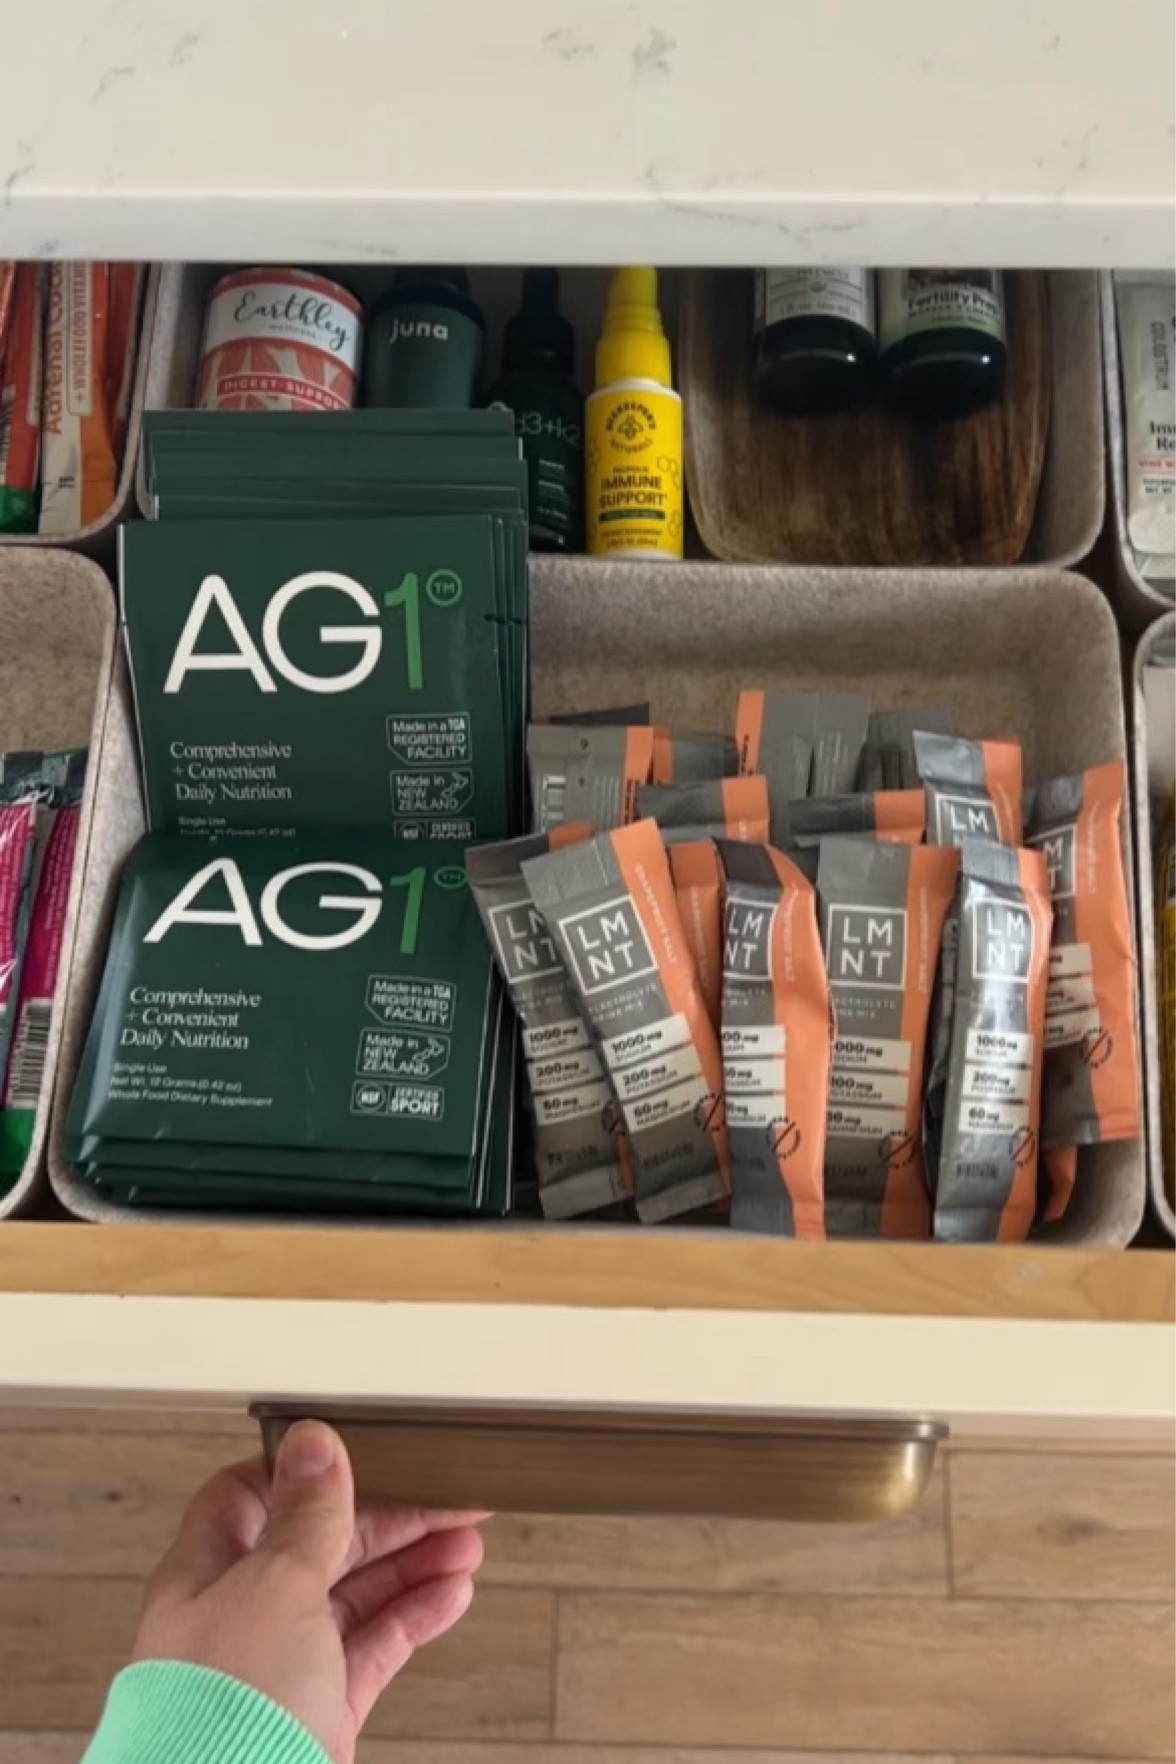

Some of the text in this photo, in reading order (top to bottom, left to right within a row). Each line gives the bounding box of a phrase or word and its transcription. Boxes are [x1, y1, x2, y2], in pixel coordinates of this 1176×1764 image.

[234, 291, 349, 351] Earthley
[389, 318, 449, 344] juna
[223, 378, 276, 392] DIGEST
[601, 476, 661, 490] IMMUNE
[600, 490, 666, 508] SUPPORT
[163, 570, 424, 694] AG1
[393, 720, 427, 733] Made
[427, 721, 438, 732] in
[393, 733, 466, 746] REGISTERED
[170, 740, 292, 763] Comprehensive
[407, 745, 466, 759] FACILITY
[188, 761, 278, 779] Convenient
[396, 774, 445, 787] Made in
[176, 782, 293, 805] Daily Nutrition
[397, 787, 427, 799] NEW
[399, 798, 459, 811] ZEALAND
[949, 803, 990, 833] LM
[142, 857, 426, 953] AG1
[576, 909, 630, 951] LM
[727, 907, 765, 939] LM
[842, 915, 893, 947] LM
[986, 908, 1026, 940] LM
[586, 941, 634, 981] NT
[839, 950, 892, 978] NT
[985, 940, 1025, 970] NT
[373, 980, 408, 994] Made
[410, 984, 423, 994] in
[130, 986, 262, 1009] Comprehensive
[371, 993, 449, 1011] REGISTERED
[142, 1006, 240, 1028] Convenient
[384, 1005, 448, 1027] FACILITY
[120, 1028, 249, 1051] Daily Nutrition
[366, 1033, 419, 1049] Made in
[529, 1027, 562, 1044] 1000
[611, 1034, 645, 1054] 1000
[364, 1046, 397, 1059] NEW
[834, 1040, 883, 1057] 000 mg
[113, 1061, 168, 1075] Single Use
[363, 1057, 429, 1077] ZEALAND
[536, 1061, 562, 1078] 200
[622, 1070, 650, 1087] 200
[142, 1089, 169, 1101] Food
[209, 1093, 274, 1107] Supplement
[543, 1096, 562, 1111] 60
[391, 1098, 440, 1117] SPORT
[634, 1102, 652, 1118] 60
